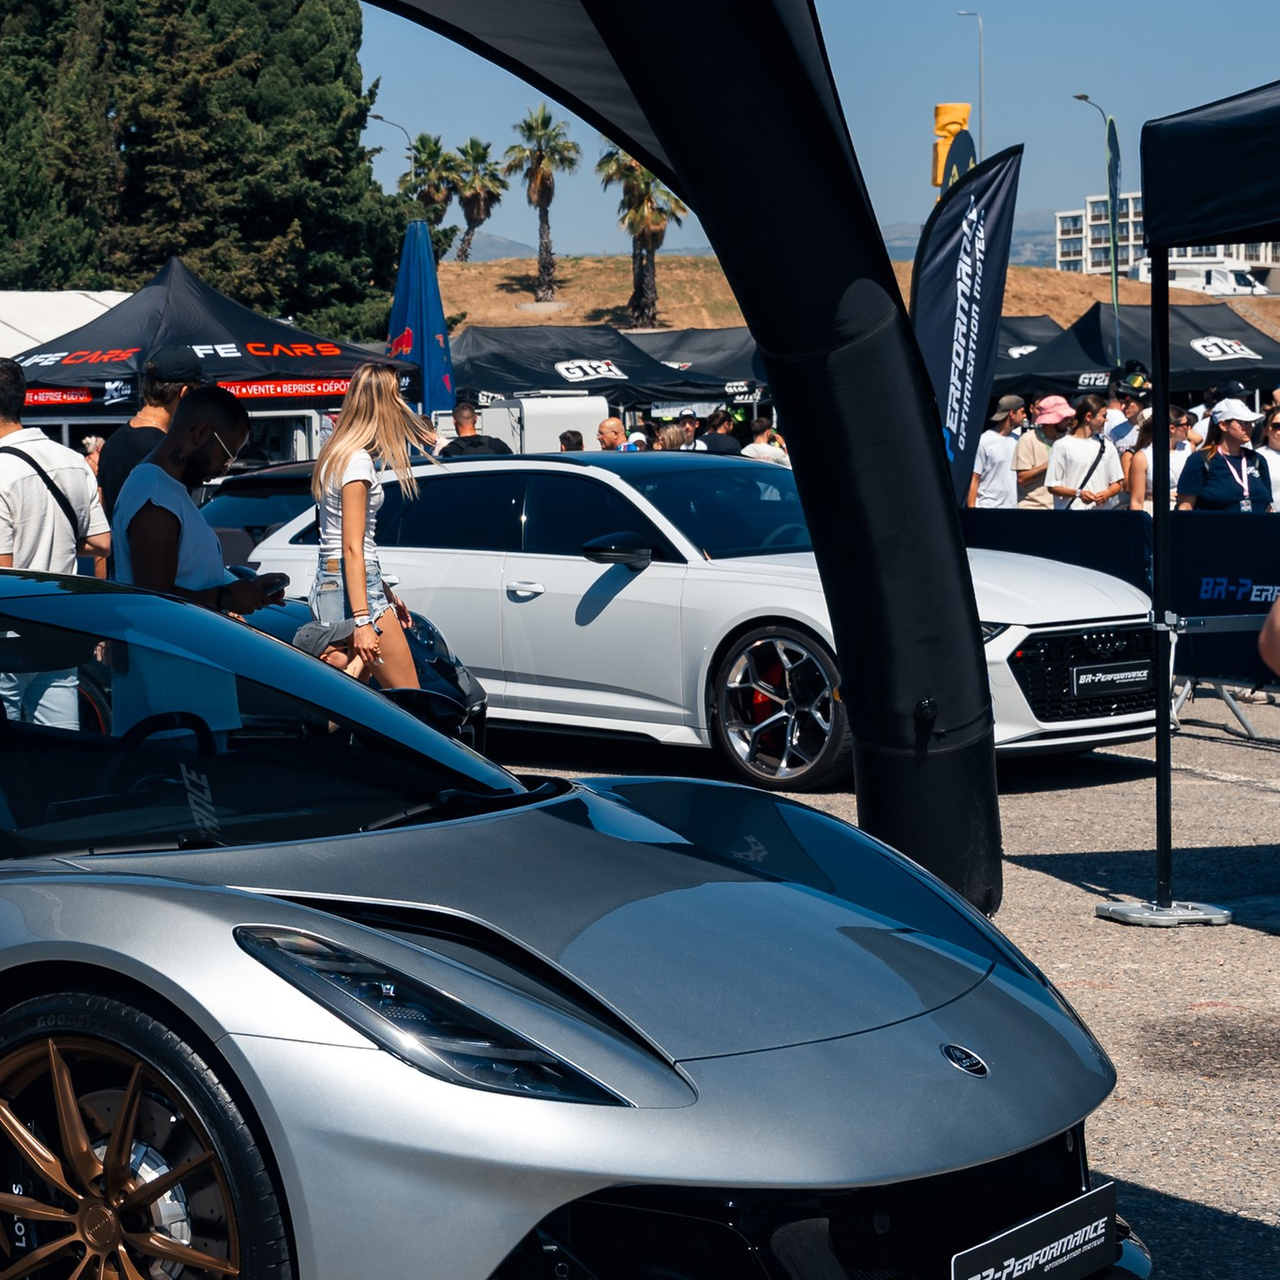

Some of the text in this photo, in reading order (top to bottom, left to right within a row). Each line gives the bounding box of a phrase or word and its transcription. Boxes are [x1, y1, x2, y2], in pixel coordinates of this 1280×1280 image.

[61, 347, 141, 366] CARS
[246, 342, 342, 357] CARS
[247, 384, 275, 395] VENTE
[283, 383, 316, 394] REPRISE
[11, 1182, 26, 1248] LOS
